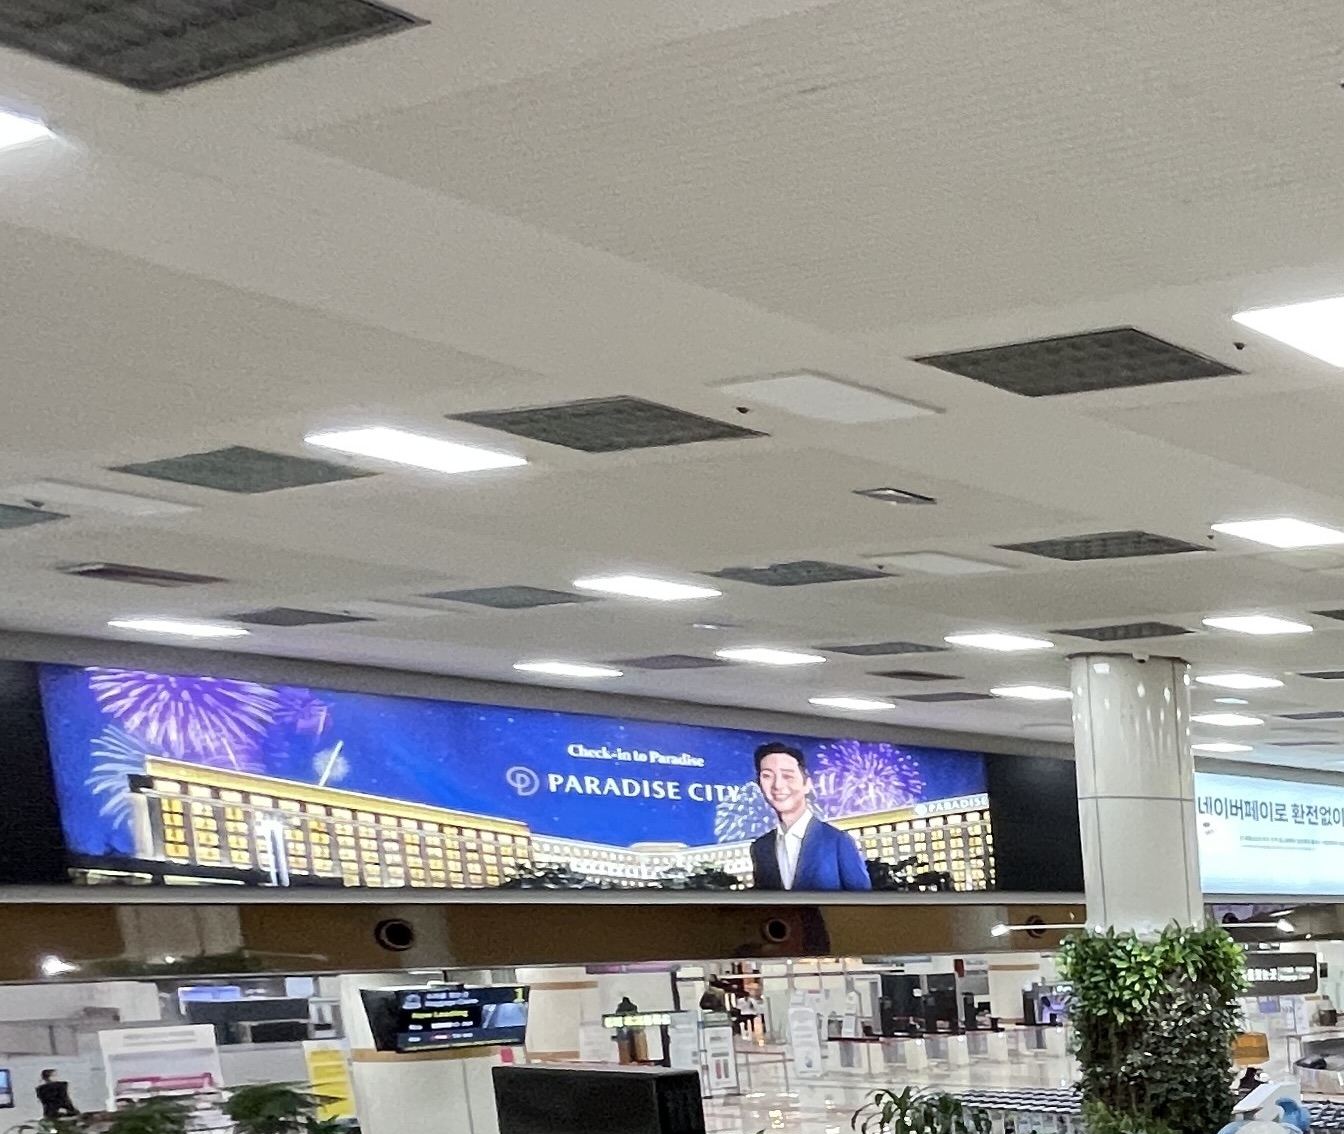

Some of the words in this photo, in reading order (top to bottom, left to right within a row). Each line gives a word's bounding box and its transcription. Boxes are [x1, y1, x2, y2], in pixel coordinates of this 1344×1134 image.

[567, 743, 631, 761] Check-in
[633, 750, 648, 763] to
[650, 750, 705, 767] Paradise
[547, 773, 682, 800] PARADISE
[688, 782, 741, 803] CITY
[1197, 796, 1289, 822] 네이버페이로
[1290, 803, 1344, 828] 환전없이
[513, 987, 525, 1004] 1
